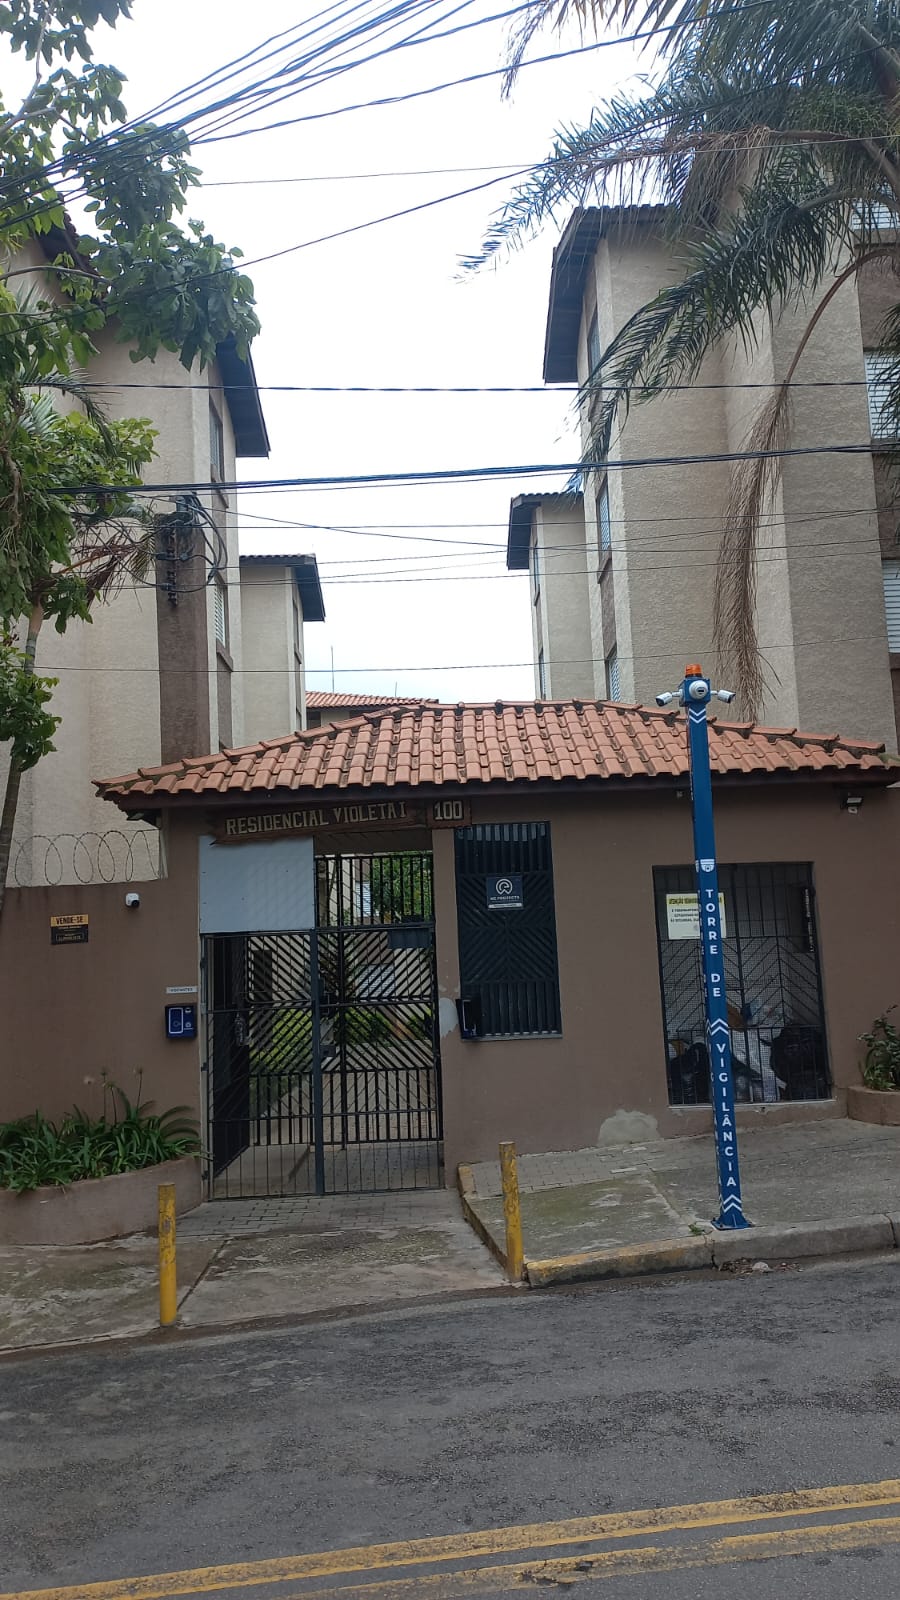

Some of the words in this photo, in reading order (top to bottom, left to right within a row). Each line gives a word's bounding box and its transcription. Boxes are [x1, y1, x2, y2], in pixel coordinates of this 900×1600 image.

[226, 809, 329, 835] RESIDENCIAL
[333, 802, 398, 824] VIOLETA
[434, 800, 463, 821] 100
[56, 916, 84, 925] VENDE-SE
[705, 889, 719, 955] TORRE
[711, 973, 721, 997] DE
[716, 1043, 737, 1187] VIGILÂNCIA
